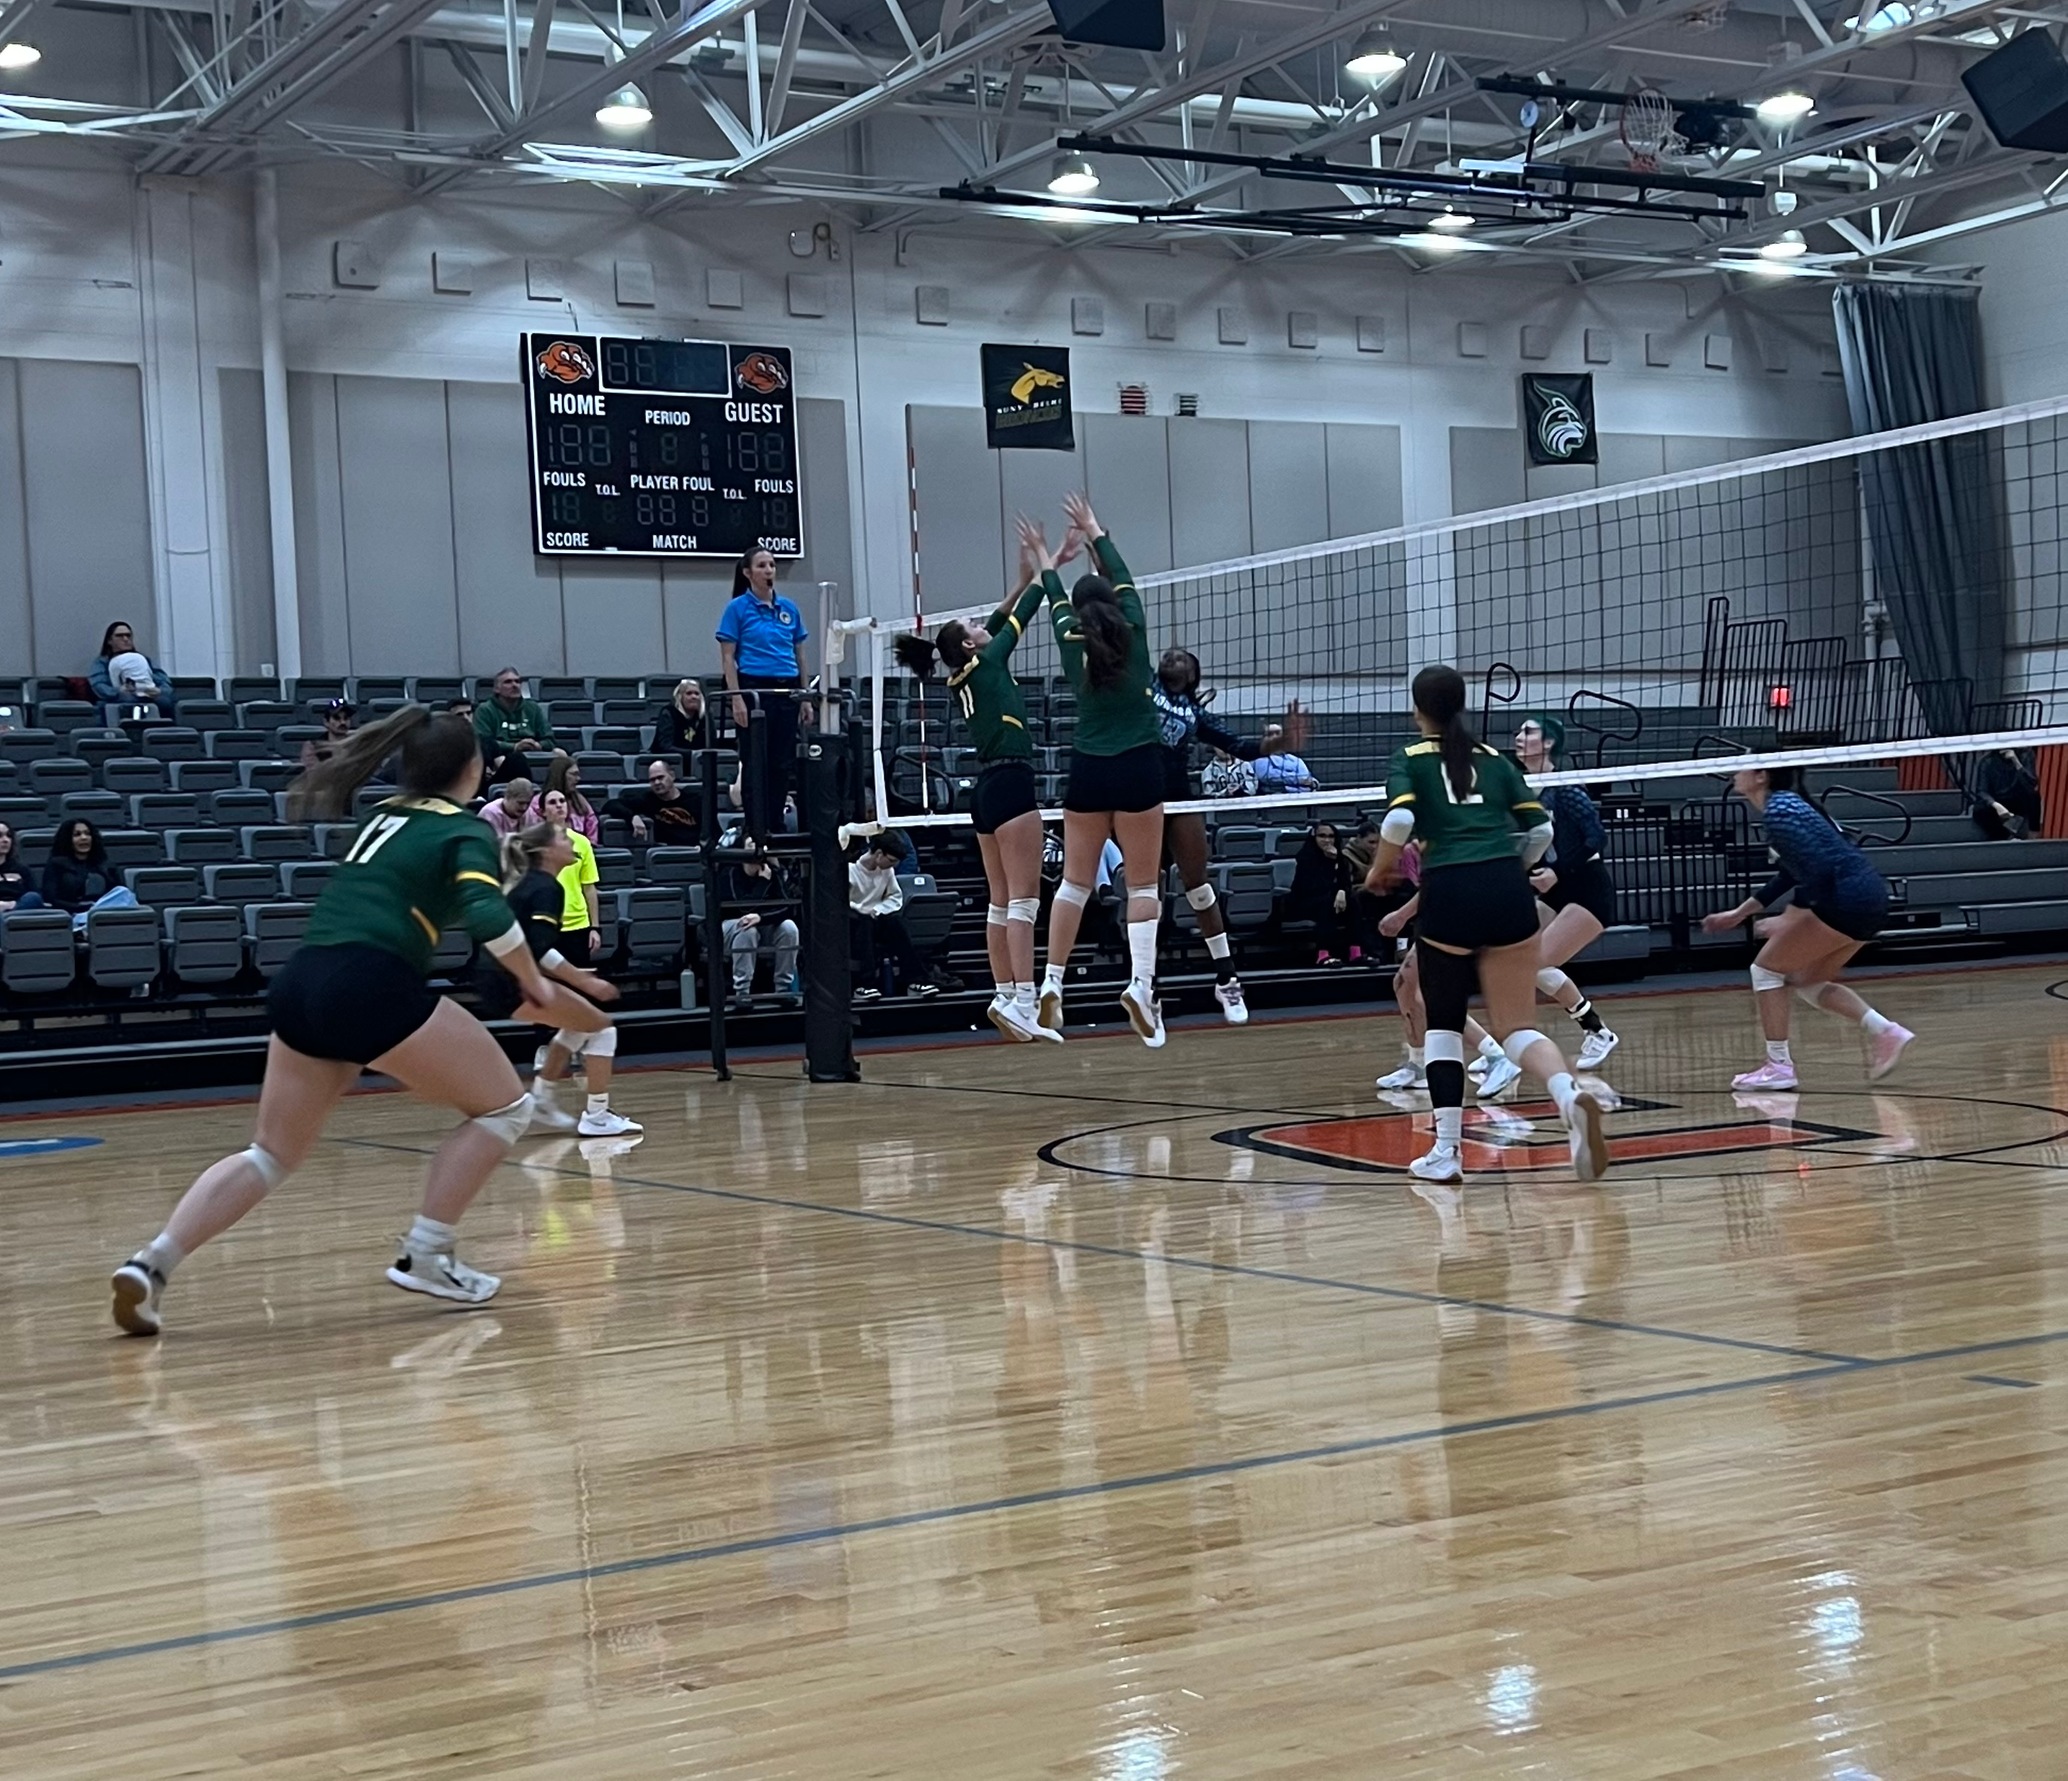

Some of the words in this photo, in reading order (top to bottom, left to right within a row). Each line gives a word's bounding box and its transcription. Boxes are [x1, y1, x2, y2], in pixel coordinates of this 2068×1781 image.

[549, 393, 606, 416] HOME
[725, 401, 784, 424] GUEST
[645, 409, 691, 426] PERIOD
[543, 471, 586, 487] FOULS
[630, 474, 679, 490] PLAYER
[682, 476, 715, 492] FOUL
[755, 478, 794, 494] FOULS
[546, 531, 590, 547] SCORE
[652, 534, 698, 550] MATCH
[757, 536, 797, 552] SCORE
[959, 683, 975, 719] 11
[344, 813, 410, 864] 17
